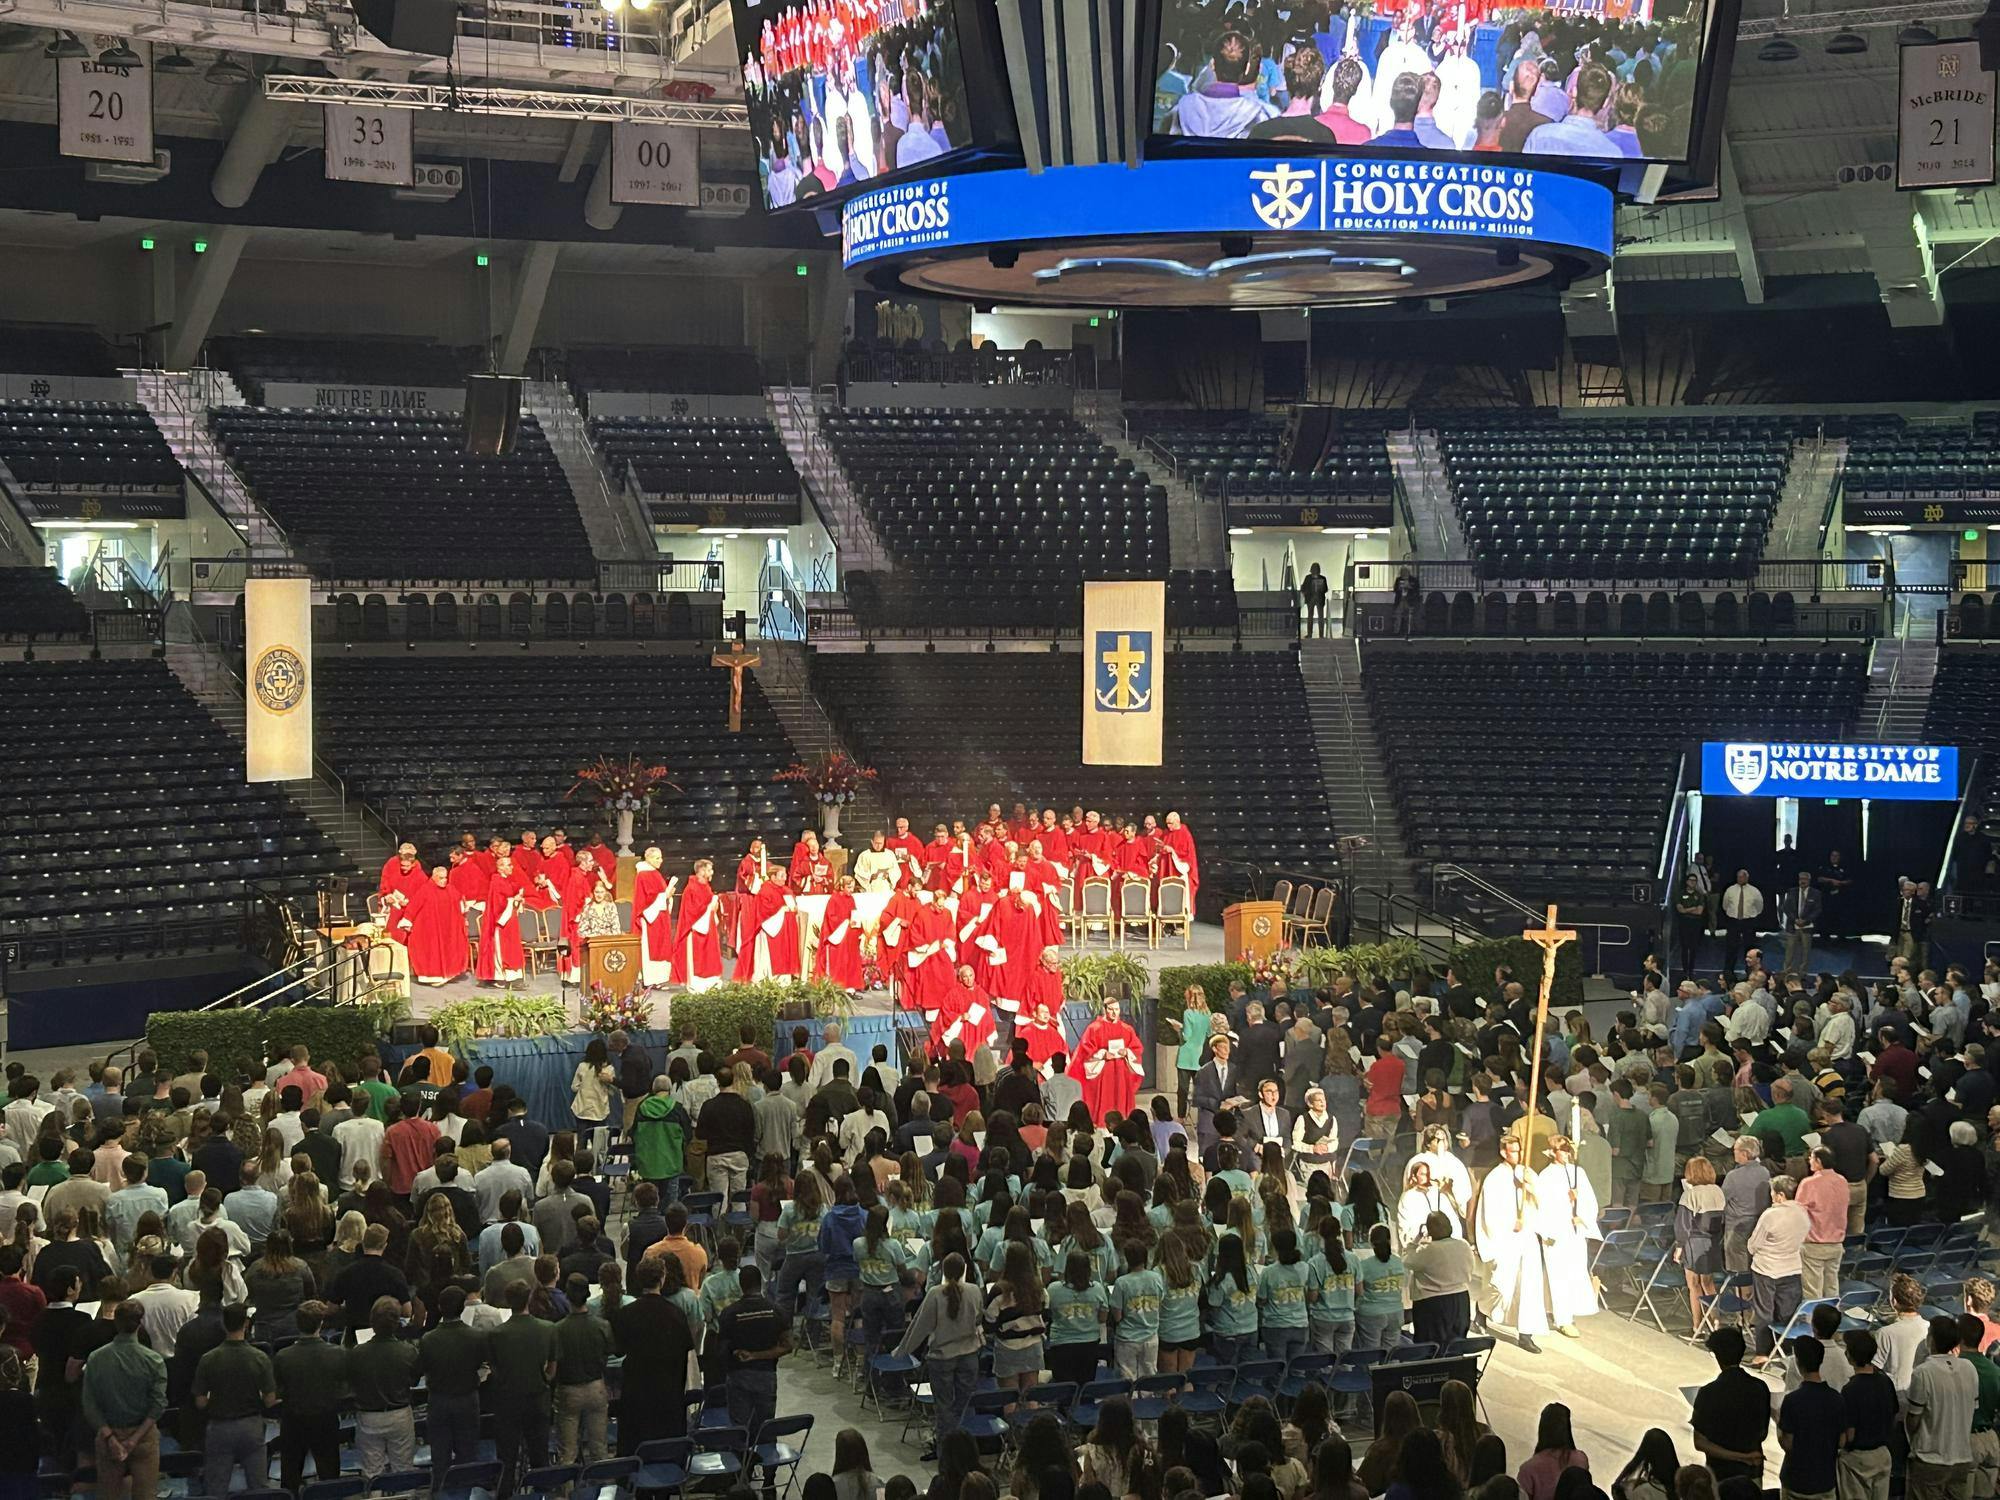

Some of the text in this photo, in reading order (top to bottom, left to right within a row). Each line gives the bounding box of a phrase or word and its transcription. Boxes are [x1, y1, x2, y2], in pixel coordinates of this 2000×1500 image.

[88, 90, 123, 121] 20
[353, 116, 384, 145] 33
[1930, 118, 1961, 146] 21
[638, 140, 671, 169] 00
[1335, 163, 1534, 187] CONGREGATION OF
[929, 181, 949, 196] OF
[1332, 180, 1534, 222] HOLY CROSS
[850, 196, 950, 246] HOLY CROSS
[1334, 217, 1534, 236] EDUCATION PARISH MISSION
[316, 388, 427, 409] NOTRE DAME
[1770, 744, 1941, 762] UNIVERSITY OF
[1769, 760, 1942, 783] NOTRE DAME
